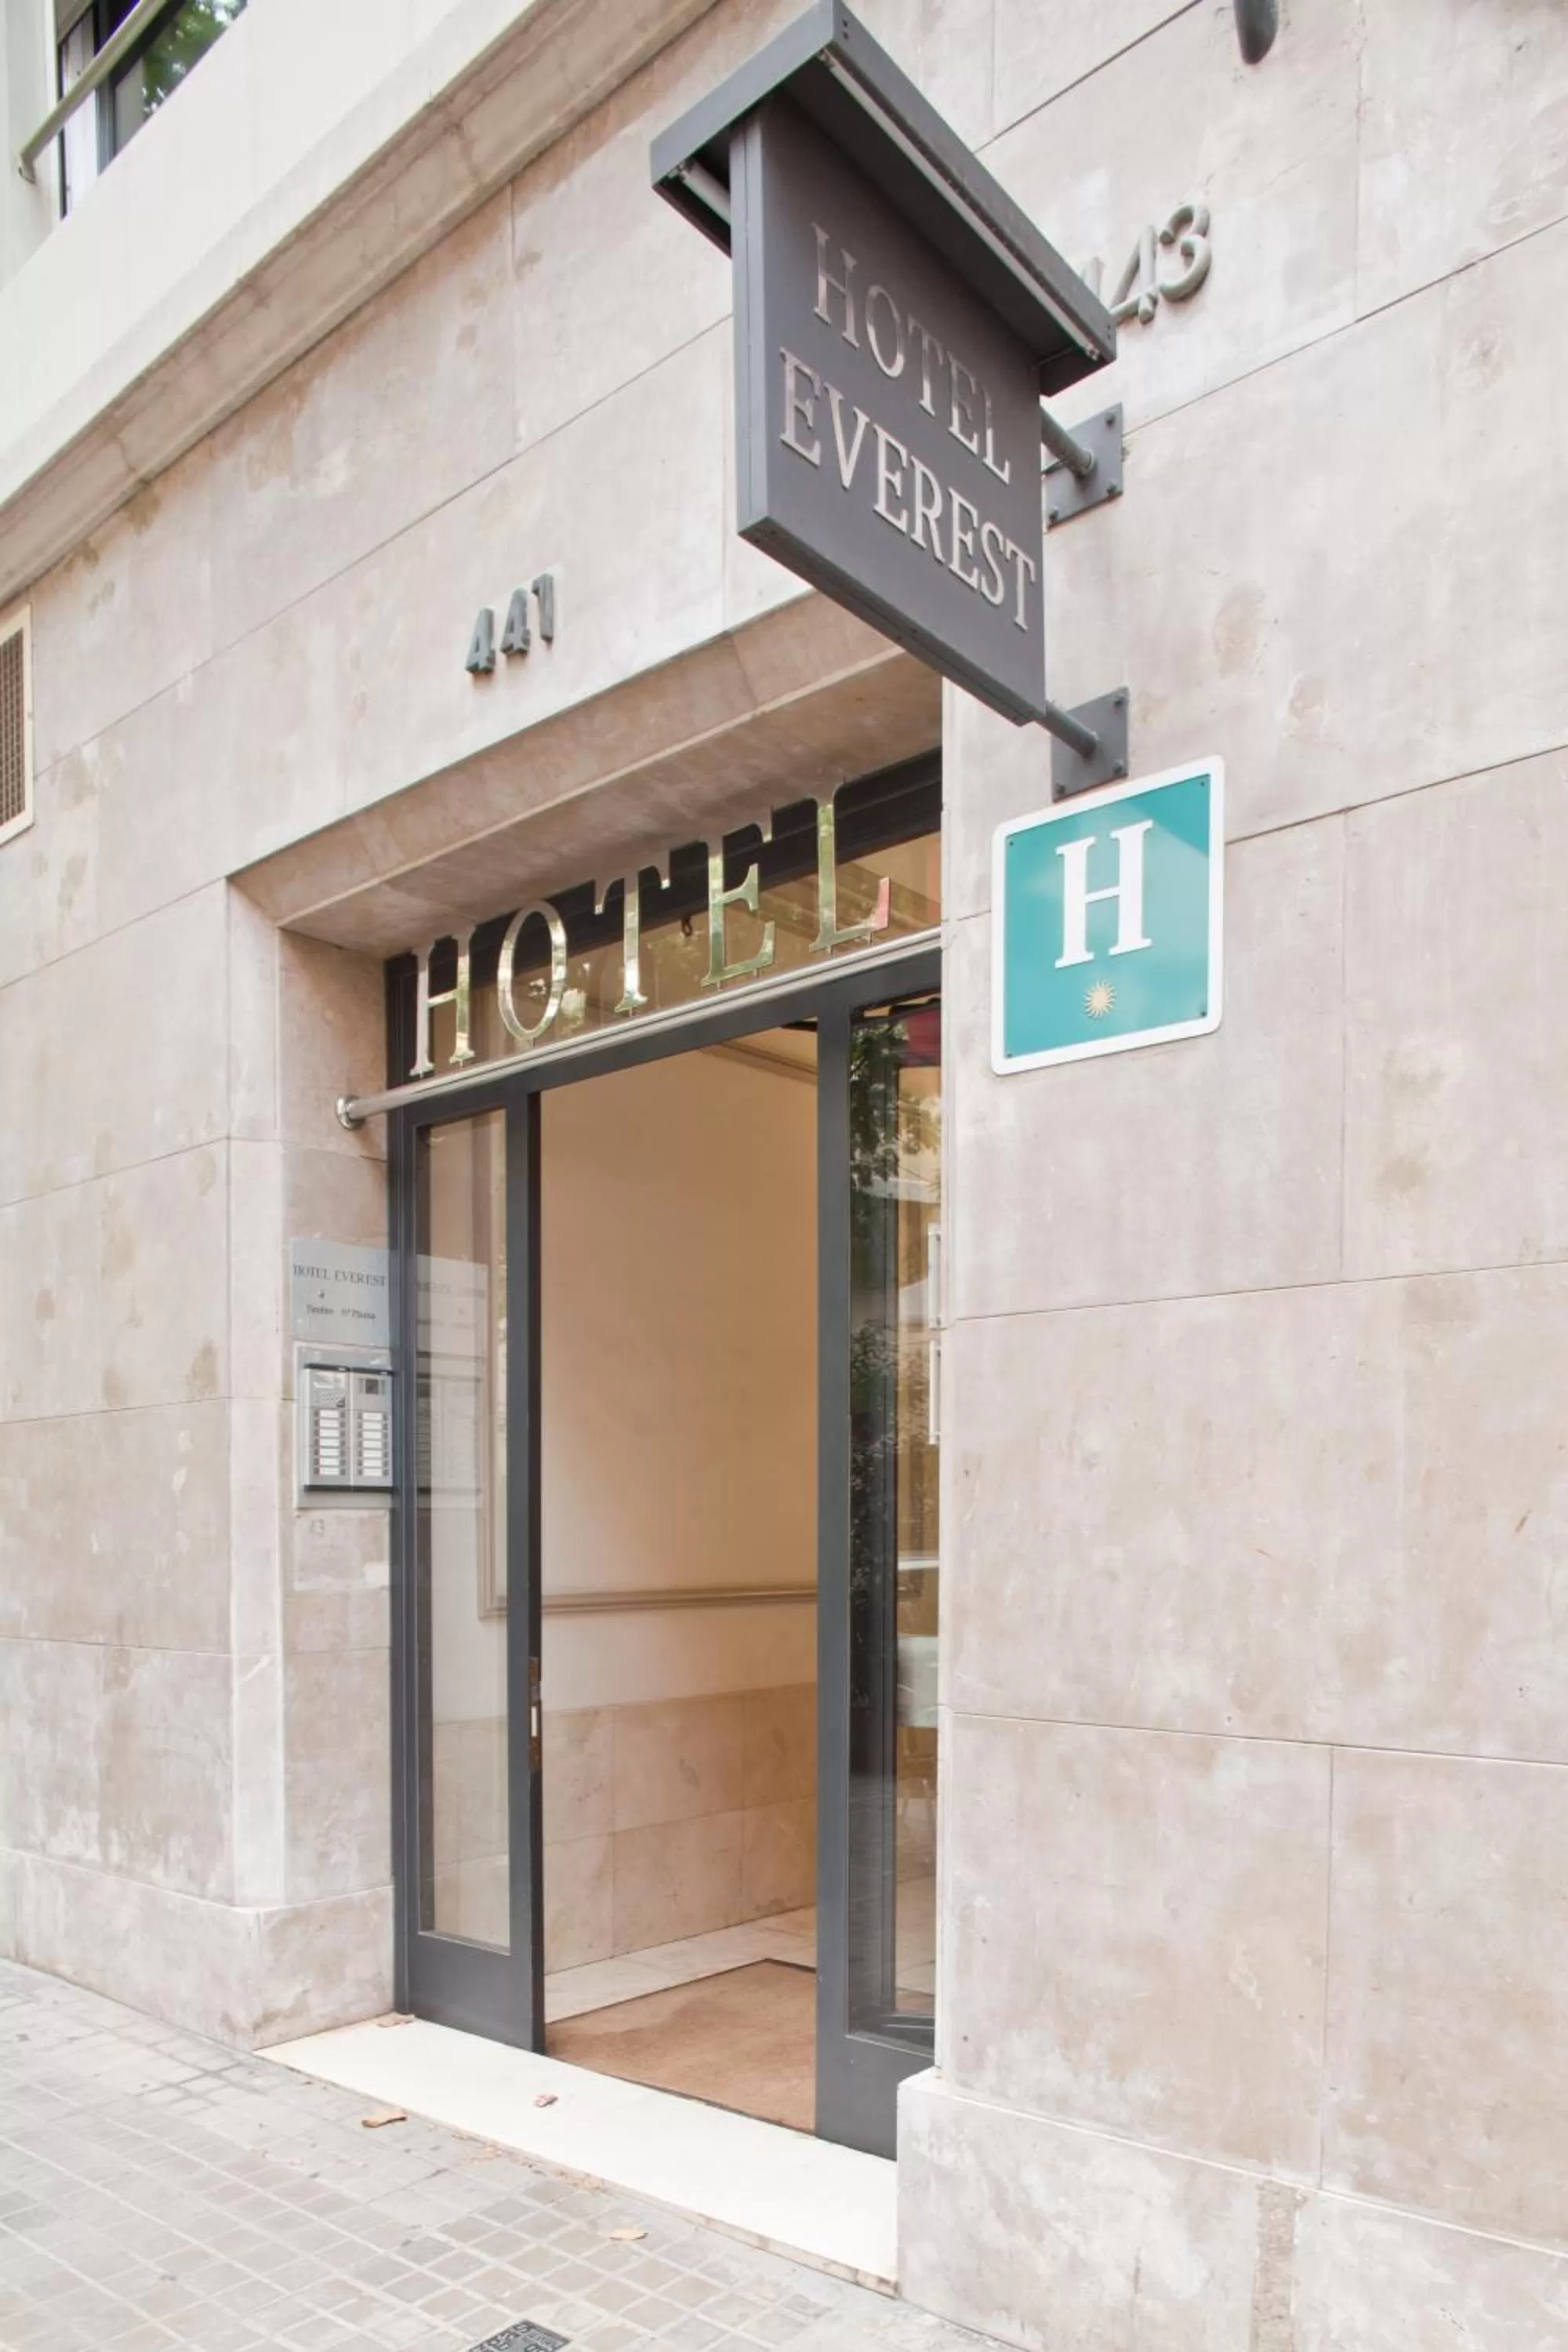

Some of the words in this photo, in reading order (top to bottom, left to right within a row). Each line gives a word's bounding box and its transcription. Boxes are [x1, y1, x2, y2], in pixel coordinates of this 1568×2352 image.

[811, 221, 1011, 486] HOTEL
[779, 347, 1036, 632] EVEREST
[464, 572, 554, 675] 441
[410, 776, 890, 1076] HOTEL
[1054, 818, 1153, 970] H
[293, 1264, 331, 1280] HOTEL
[335, 1269, 387, 1287] EVEREST
